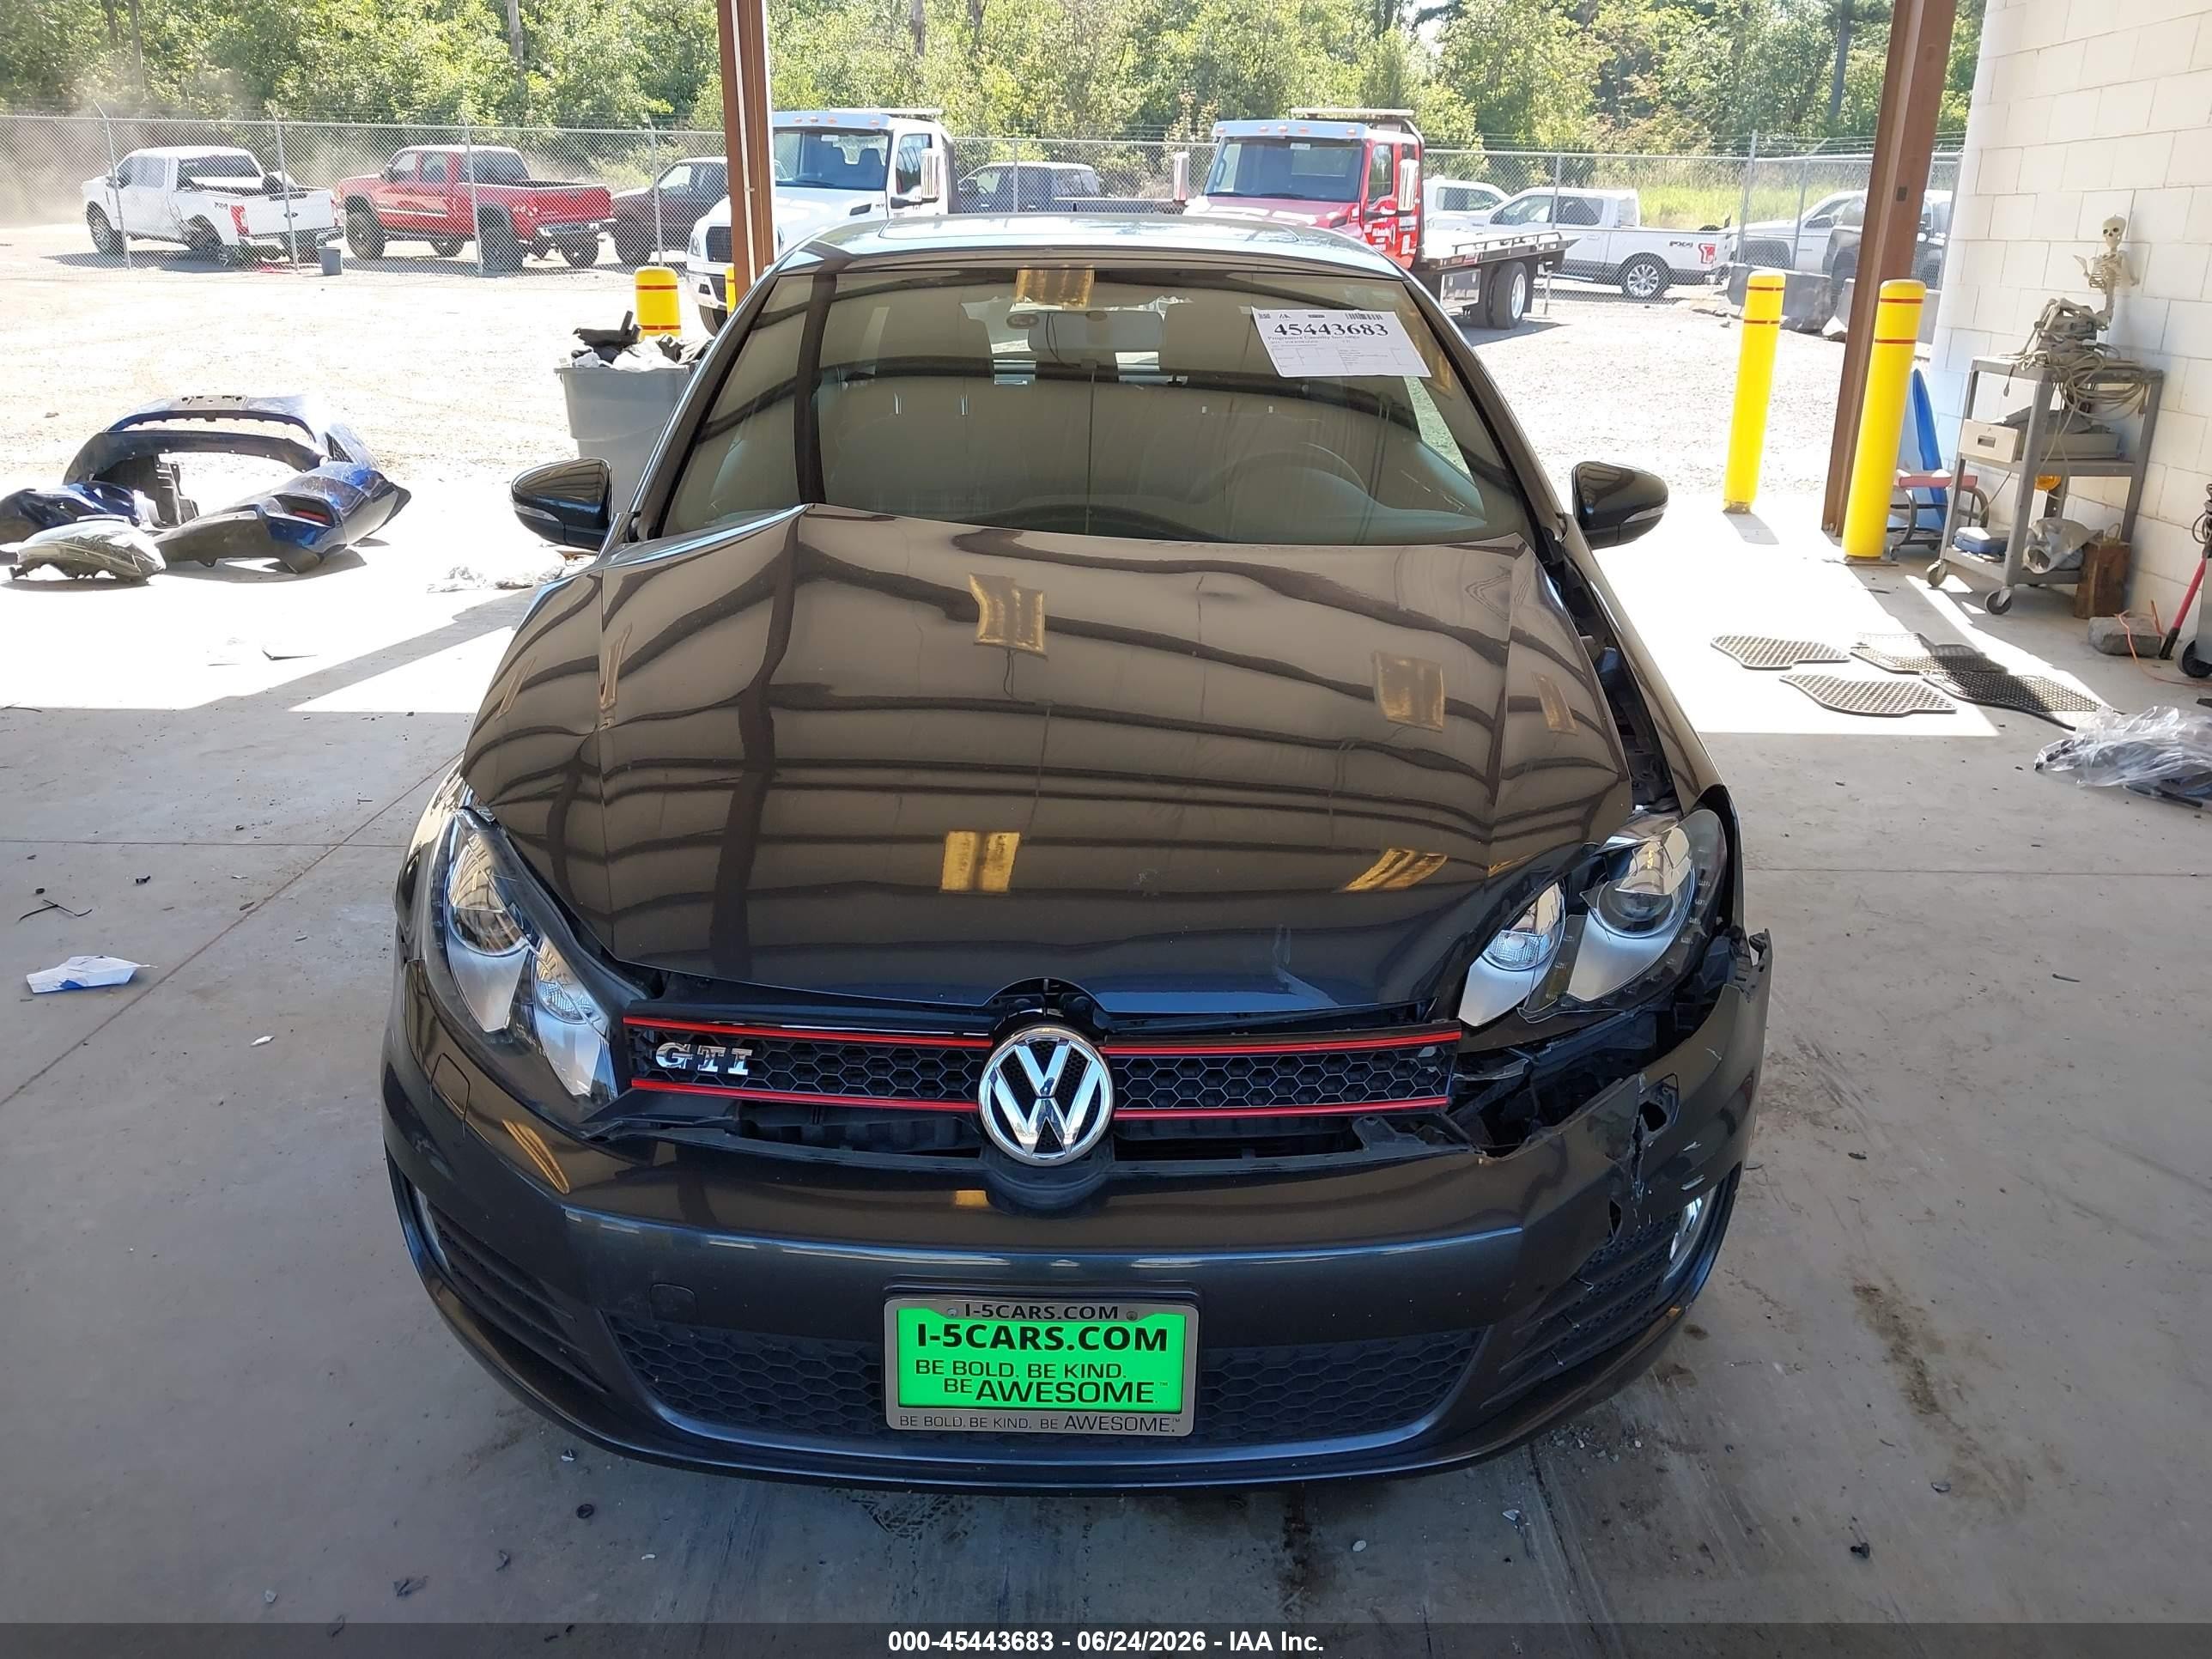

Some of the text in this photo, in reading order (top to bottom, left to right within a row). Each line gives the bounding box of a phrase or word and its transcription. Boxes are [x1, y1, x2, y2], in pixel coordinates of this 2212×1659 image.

[1274, 323, 1389, 337] 45443683
[655, 1042, 754, 1076] GTI
[965, 1304, 1119, 1320] I-5CARS.COM
[918, 1323, 1168, 1352] I-5CARS.COM
[915, 1359, 1127, 1379] BE BOLD. BE KIND.
[944, 1377, 973, 1394] BE
[900, 1415, 918, 1426] BE
[924, 1416, 966, 1427] BOLD.
[969, 1417, 988, 1428] BE
[994, 1417, 1031, 1429] KIND.
[1040, 1419, 1058, 1430] BE
